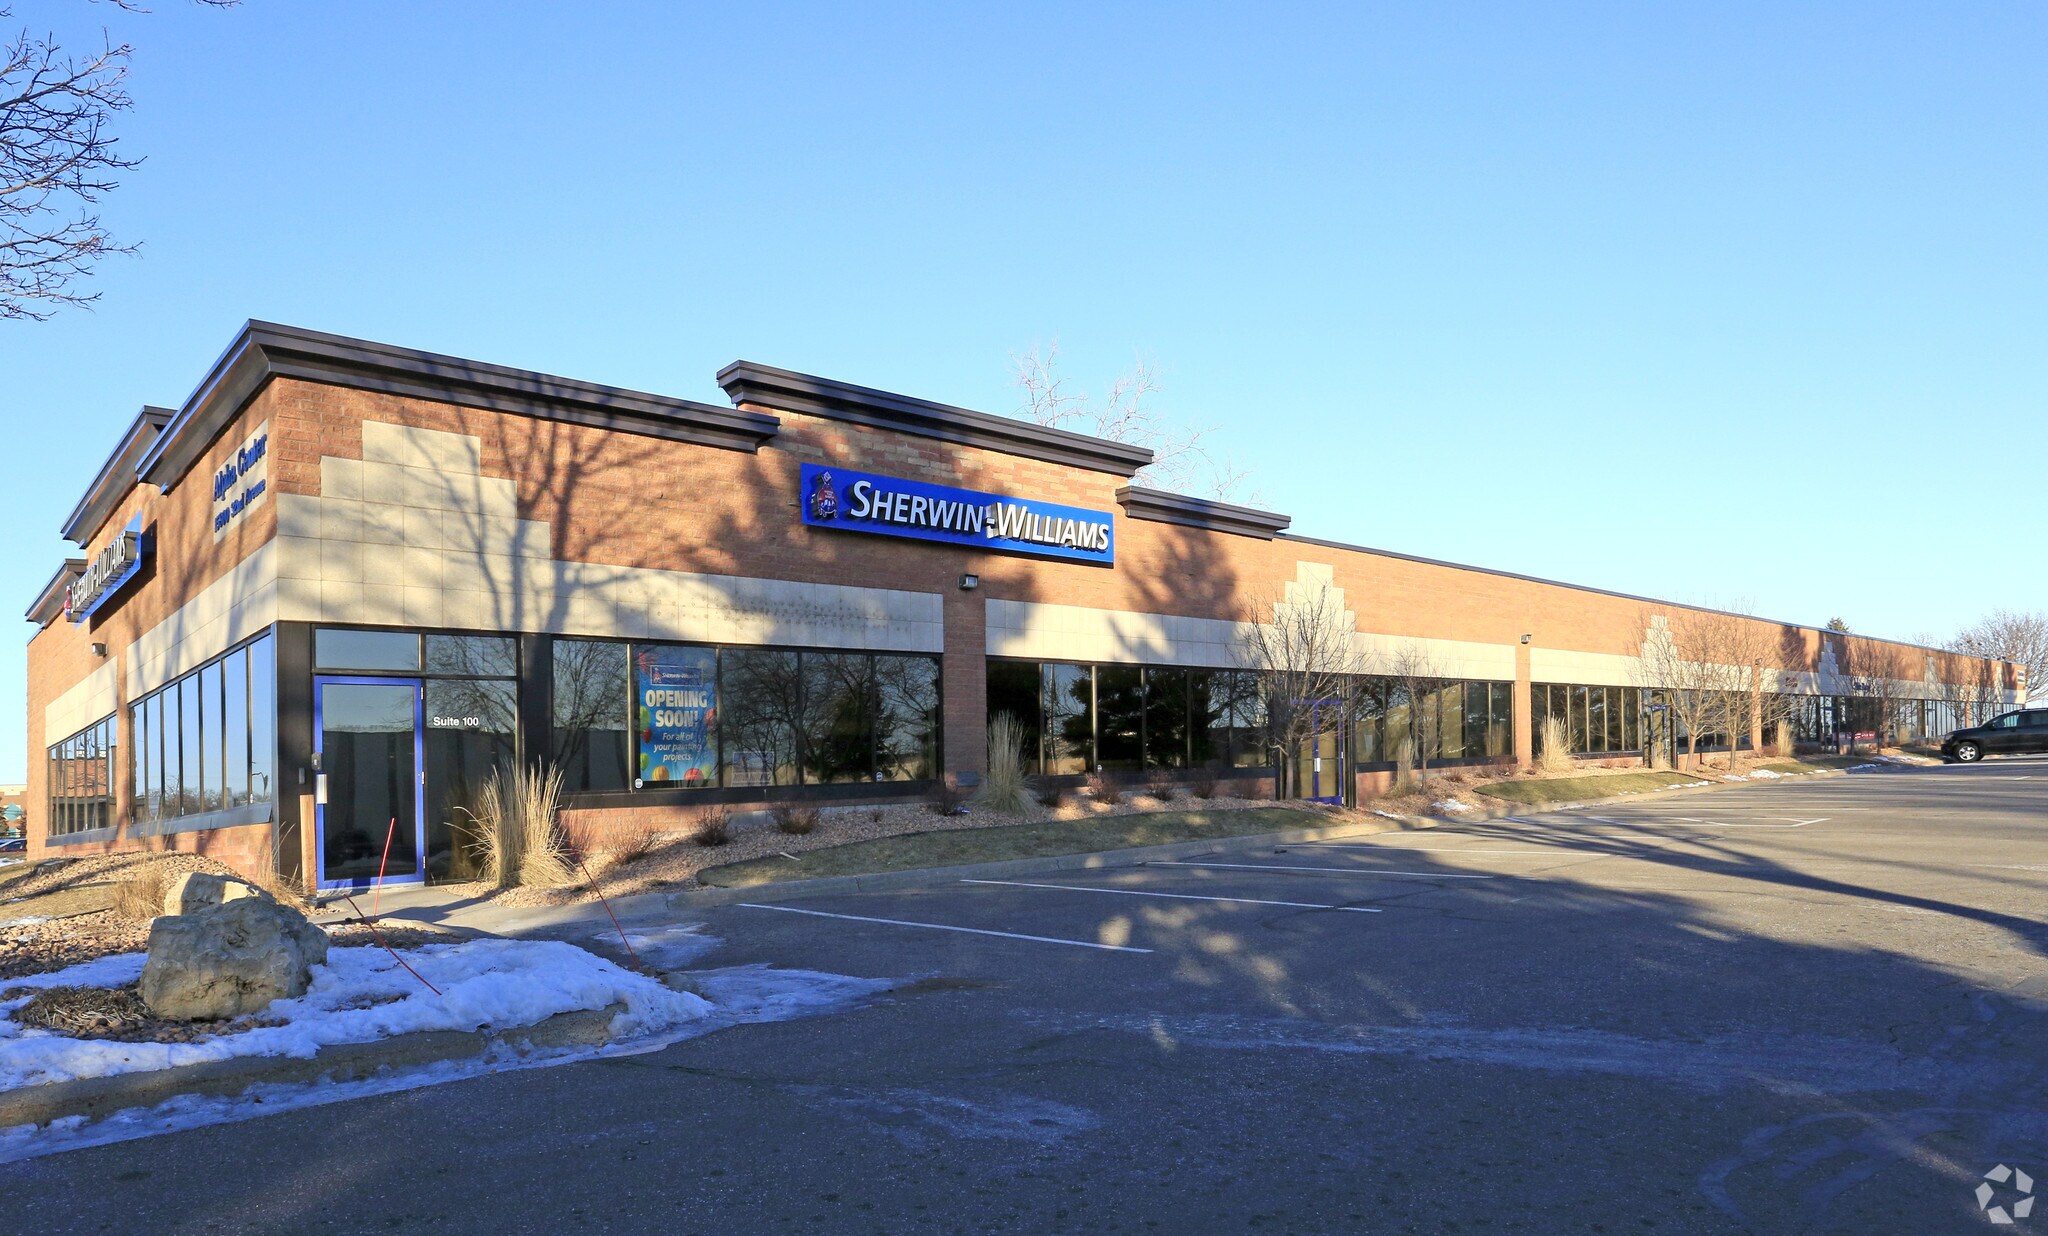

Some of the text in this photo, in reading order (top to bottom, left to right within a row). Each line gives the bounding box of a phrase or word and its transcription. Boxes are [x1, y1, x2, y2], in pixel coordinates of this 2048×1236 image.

[213, 434, 268, 501] Alpha Center
[850, 480, 1109, 550] SHERWIN-WILLIAMS
[645, 690, 707, 707] OPENING
[433, 716, 479, 726] Suite 100
[655, 709, 698, 727] SOON!
[663, 732, 693, 740] For all of
[654, 744, 671, 753] your
[663, 753, 692, 762] projects.
